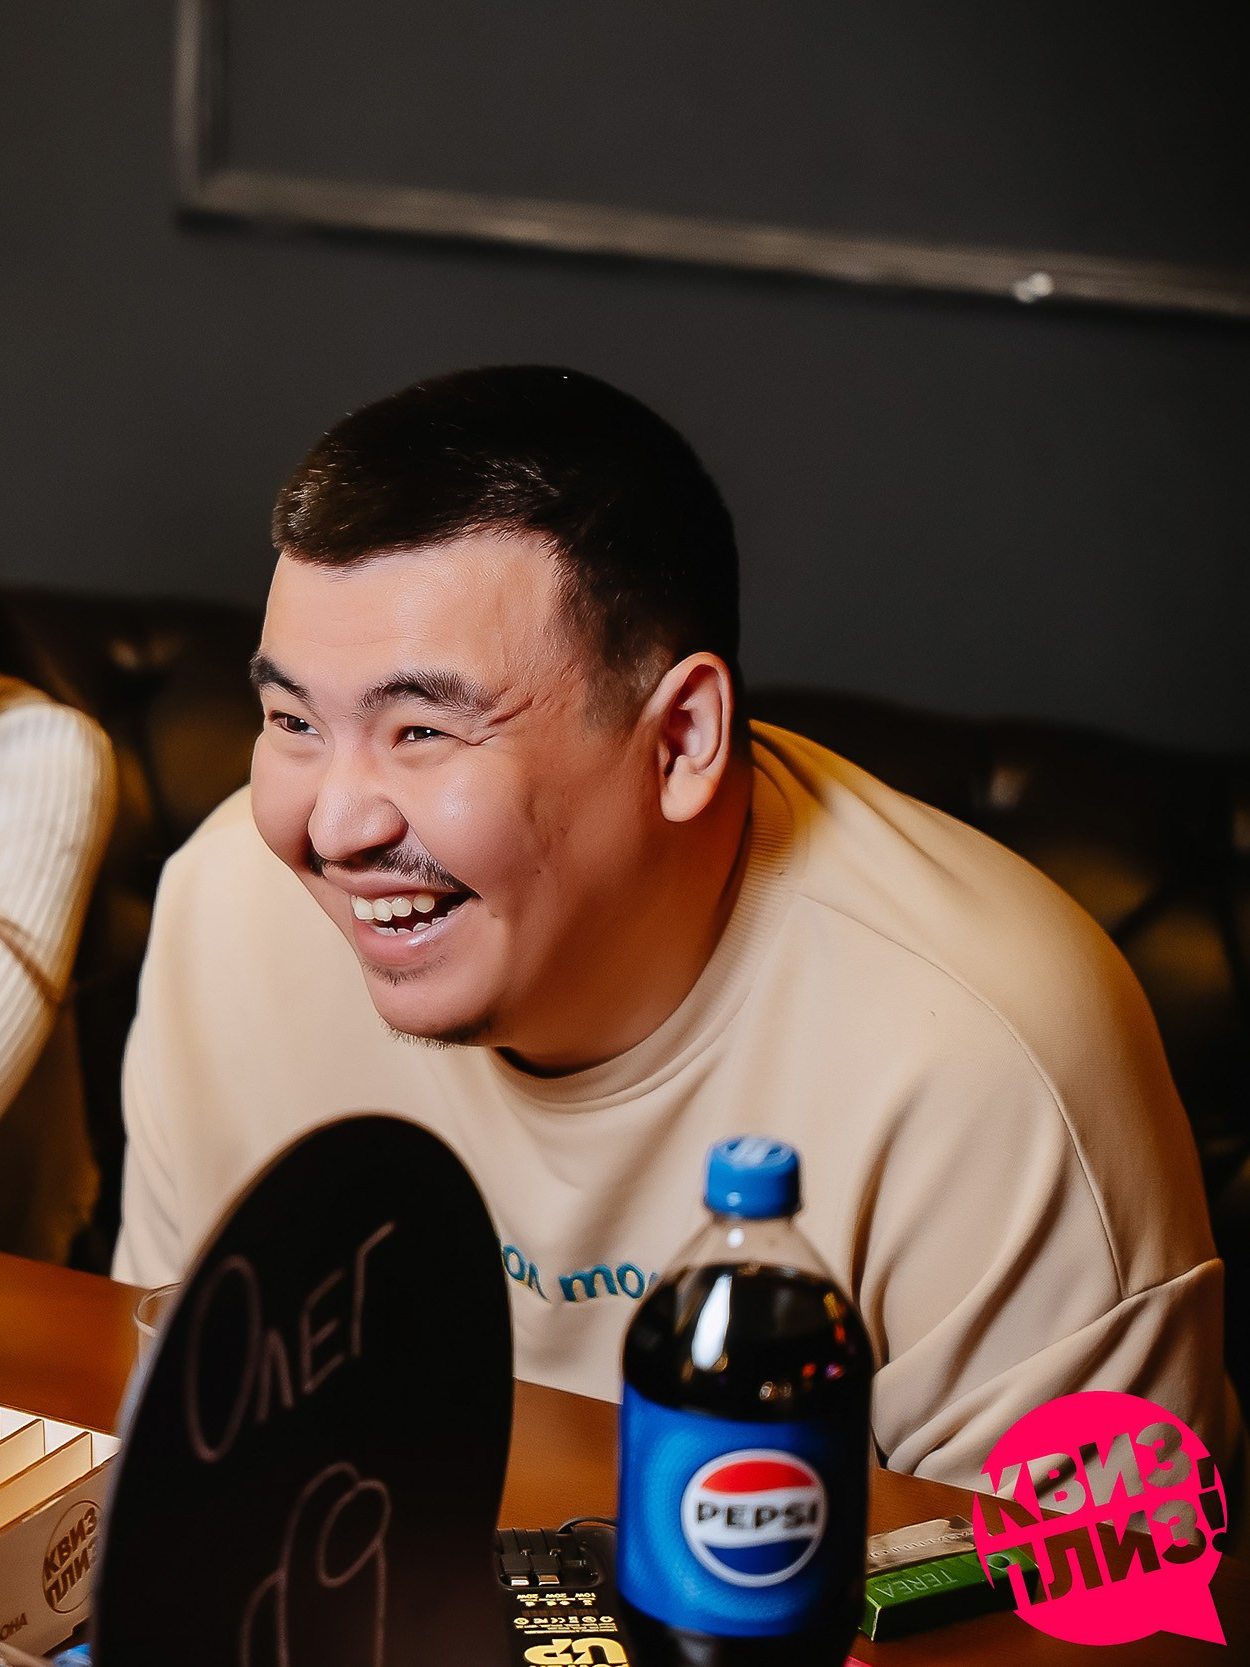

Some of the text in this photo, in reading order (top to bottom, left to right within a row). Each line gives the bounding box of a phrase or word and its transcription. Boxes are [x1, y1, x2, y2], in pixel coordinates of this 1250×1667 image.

[696, 1500, 818, 1529] PEPSI
[875, 1570, 958, 1599] TEREA
[523, 1637, 628, 1665] UP
